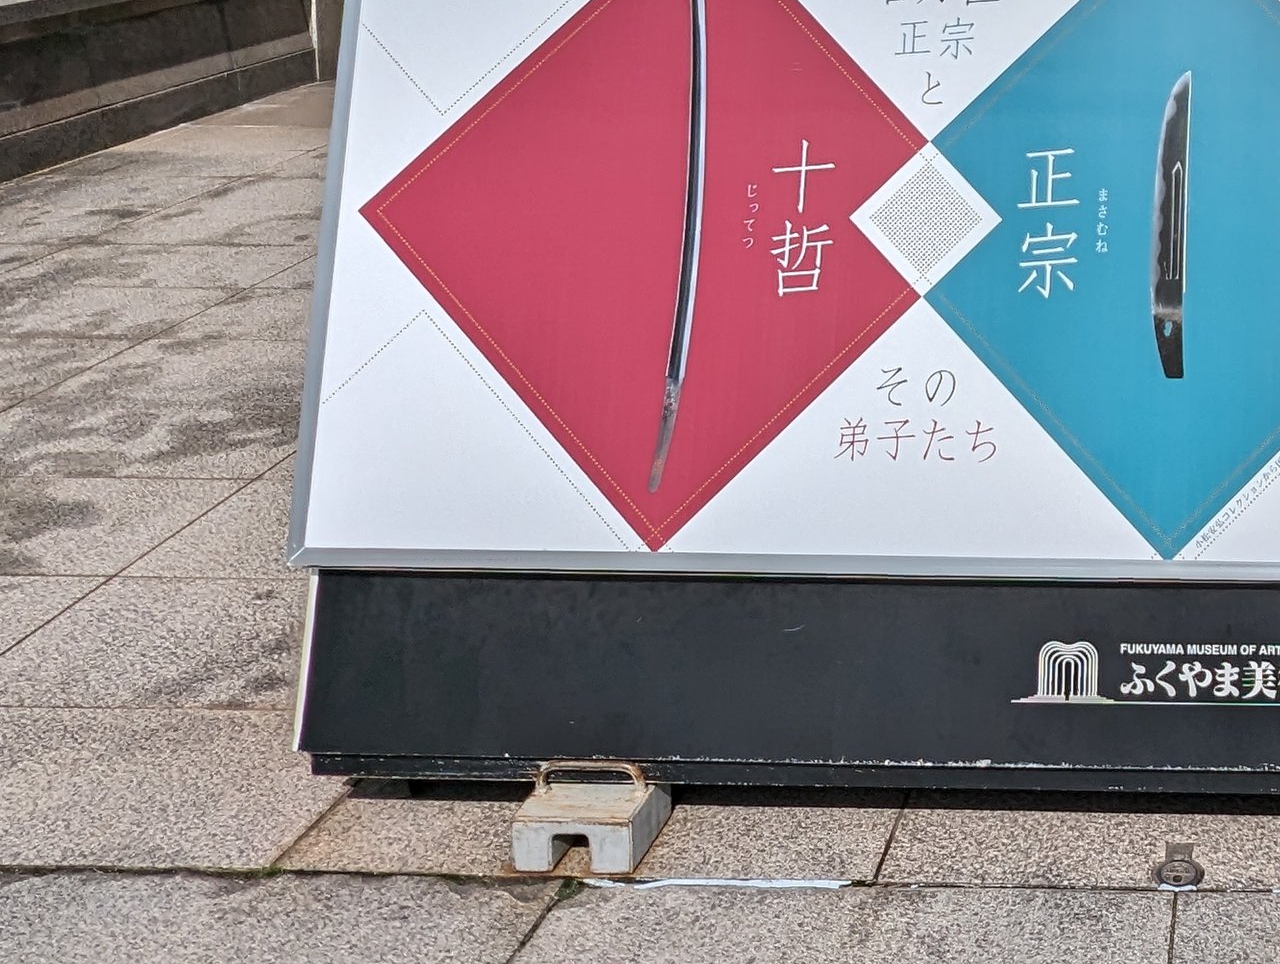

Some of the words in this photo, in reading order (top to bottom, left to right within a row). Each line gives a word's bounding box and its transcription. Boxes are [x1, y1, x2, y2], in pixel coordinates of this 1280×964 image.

[894, 16, 975, 60] 正宗
[921, 71, 943, 105] と
[742, 184, 759, 249] じってつ
[769, 139, 836, 297] 十哲
[1016, 148, 1081, 299] 正宗
[1095, 187, 1109, 253] まさむね
[876, 366, 956, 407] その
[833, 416, 997, 463] 弟子たち
[1119, 642, 1185, 655] FUKUYAMA
[1186, 643, 1238, 656] MUSEUM
[1239, 644, 1257, 656] OF
